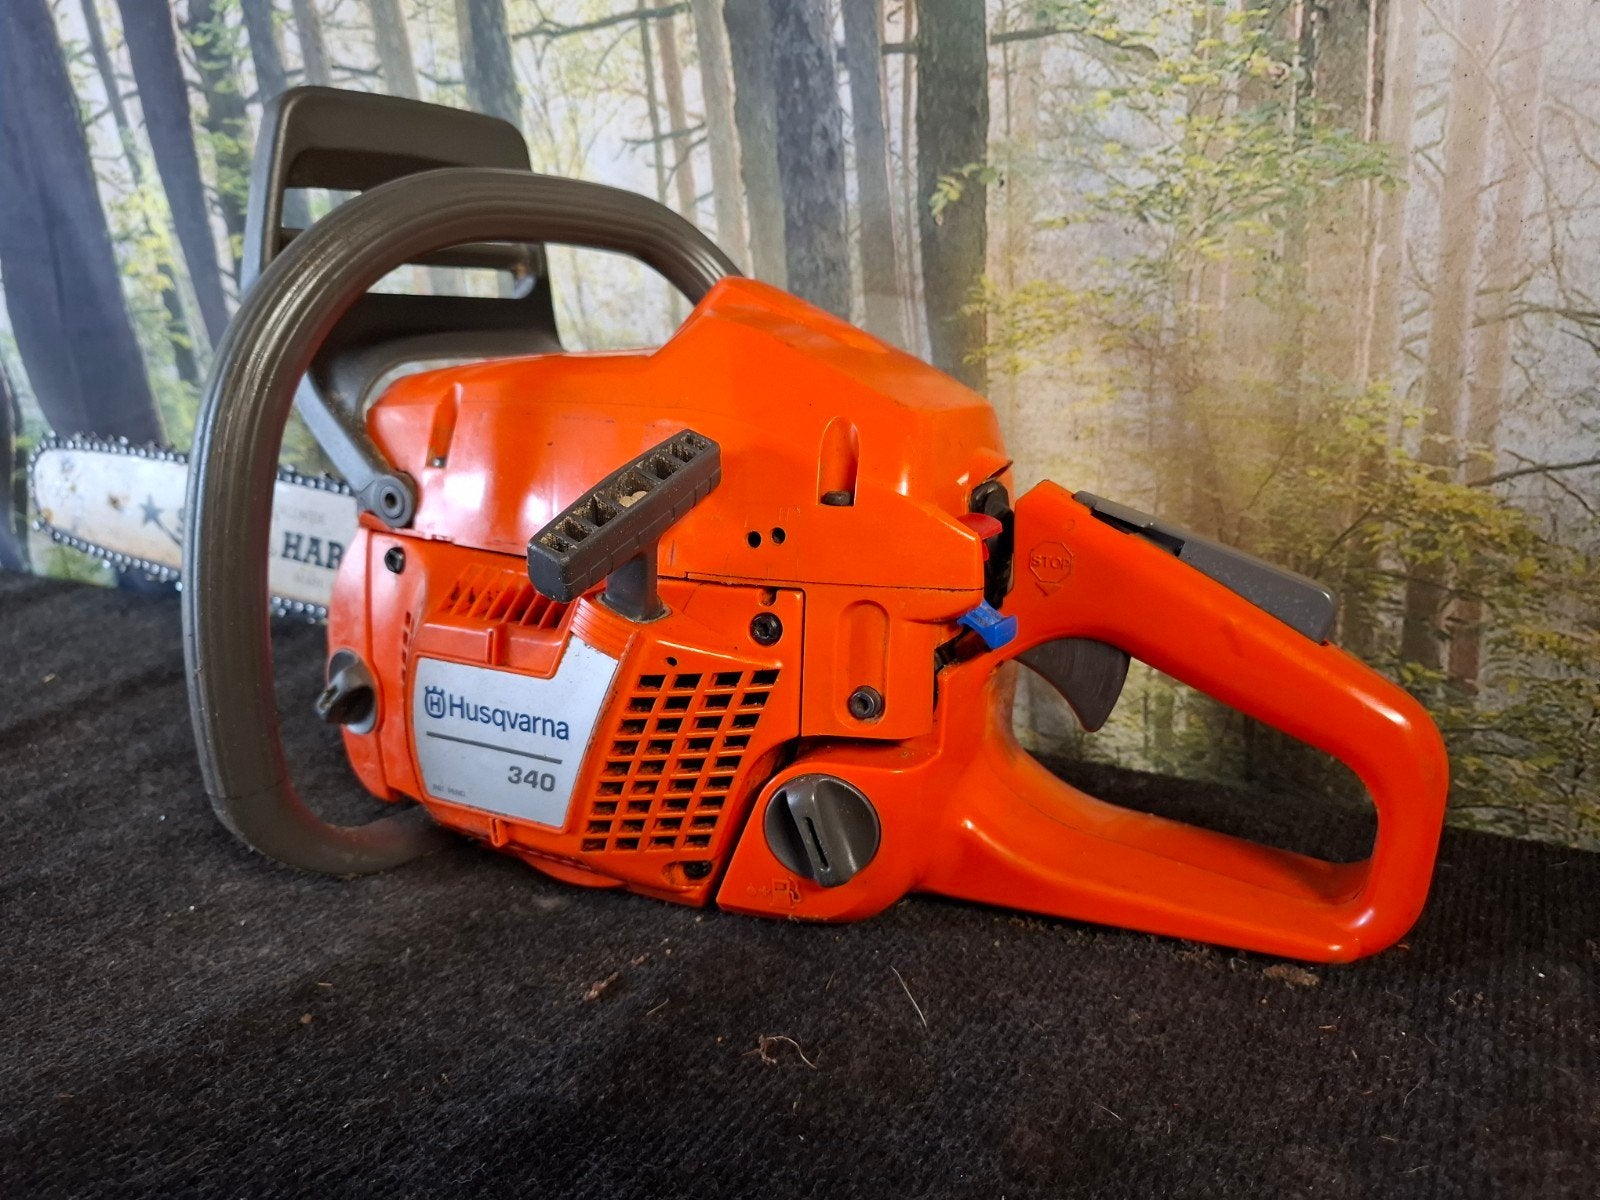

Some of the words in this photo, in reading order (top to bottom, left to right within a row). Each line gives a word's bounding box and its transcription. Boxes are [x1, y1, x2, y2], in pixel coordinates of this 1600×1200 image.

[1031, 555, 1069, 570] STOP
[449, 693, 570, 740] Husqvarna
[507, 765, 556, 793] 340
